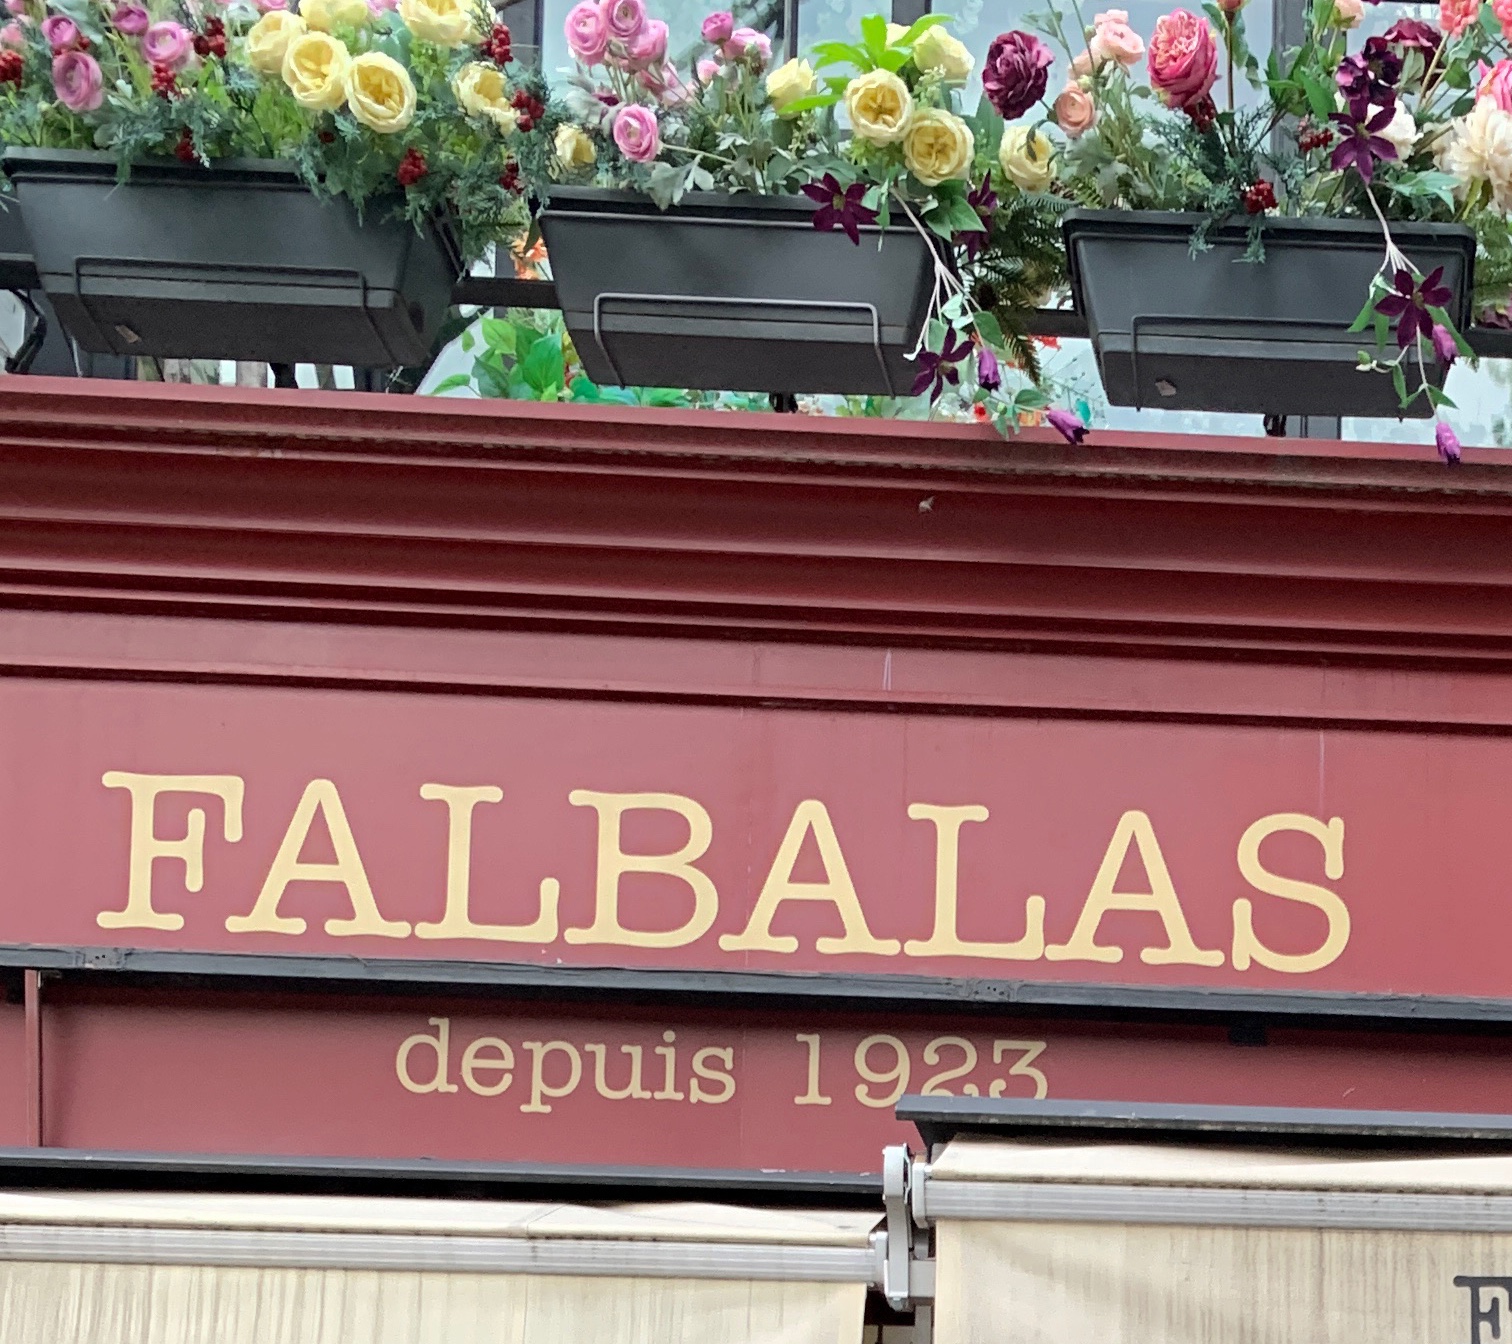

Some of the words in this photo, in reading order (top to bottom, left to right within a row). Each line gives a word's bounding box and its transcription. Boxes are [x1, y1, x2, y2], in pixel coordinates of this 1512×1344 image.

[96, 771, 1351, 974] FALBALAS
[395, 1016, 738, 1114] depuis
[793, 1032, 1049, 1108] 1923
